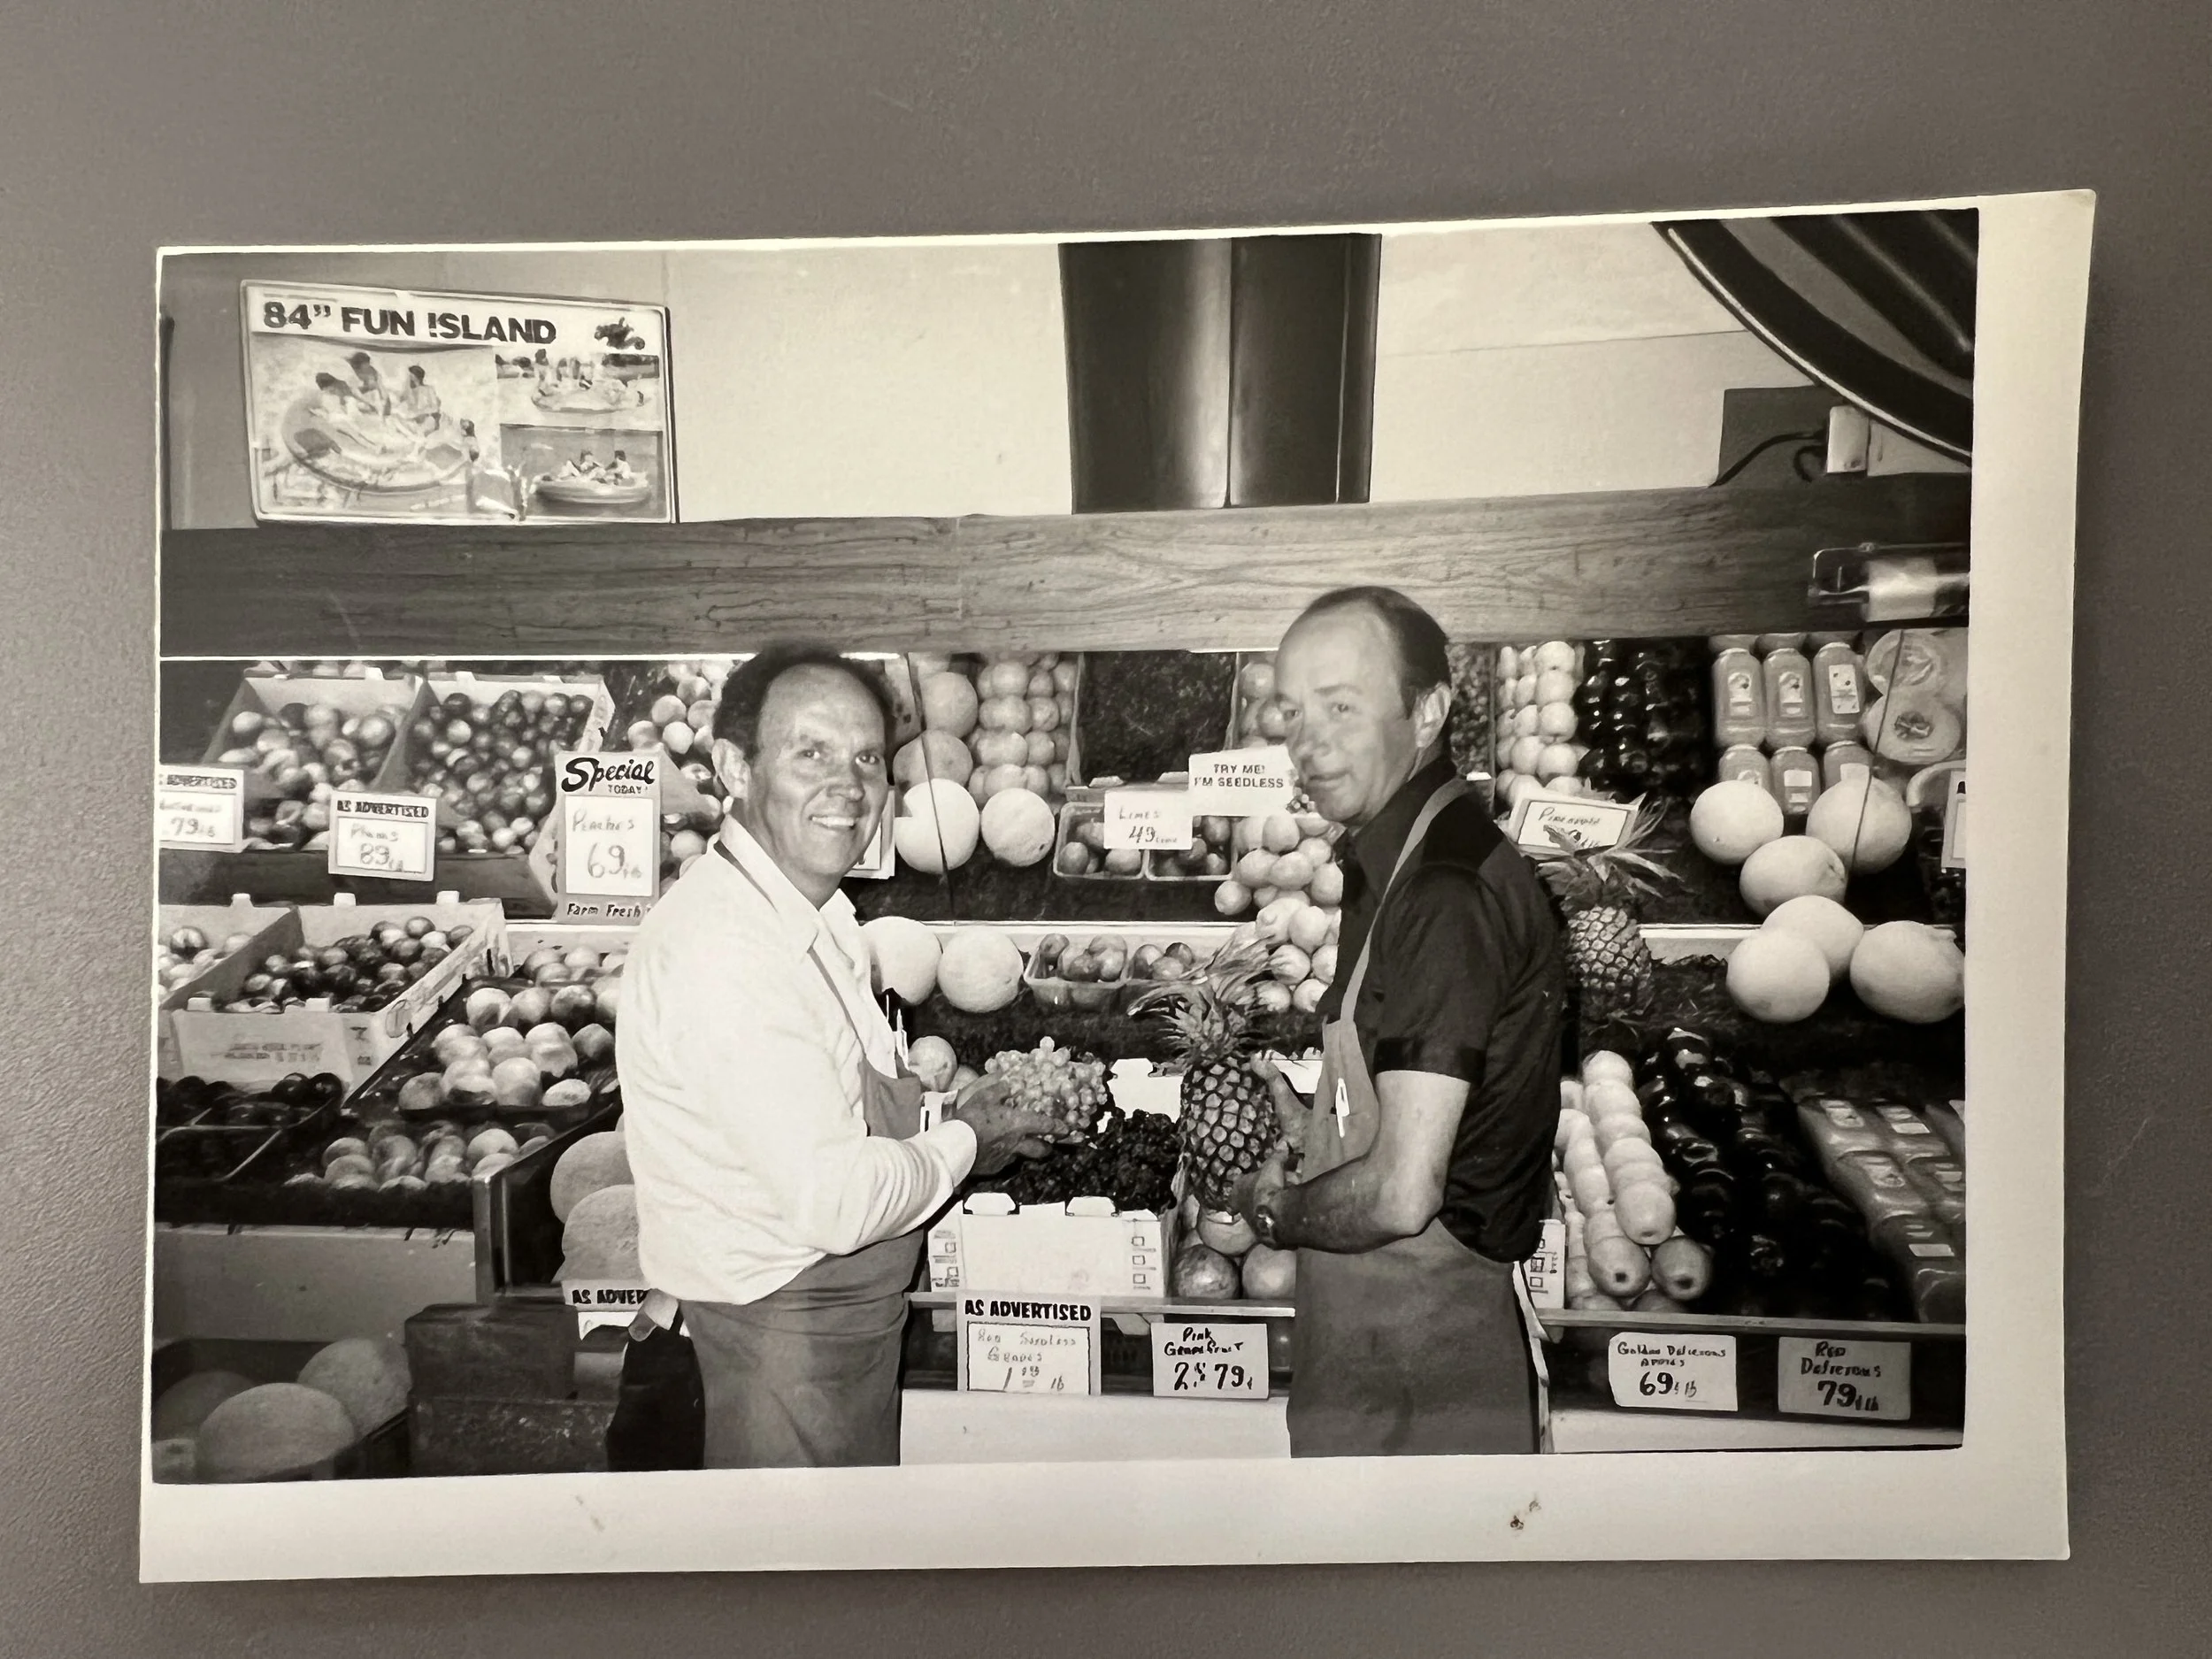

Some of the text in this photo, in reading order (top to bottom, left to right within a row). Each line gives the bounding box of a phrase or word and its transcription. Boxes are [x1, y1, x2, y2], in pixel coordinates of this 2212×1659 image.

[342, 306, 416, 337] FUN
[428, 312, 557, 345] ISLAND
[561, 757, 655, 793] Special
[1214, 764, 1237, 774] TRY
[1217, 777, 1284, 788] SEEDLESS
[567, 903, 641, 918] Farm Fresh
[572, 1289, 592, 1304] AS
[964, 1300, 1092, 1321] AS ADVERTISED
[1173, 1362, 1189, 1391] 2
